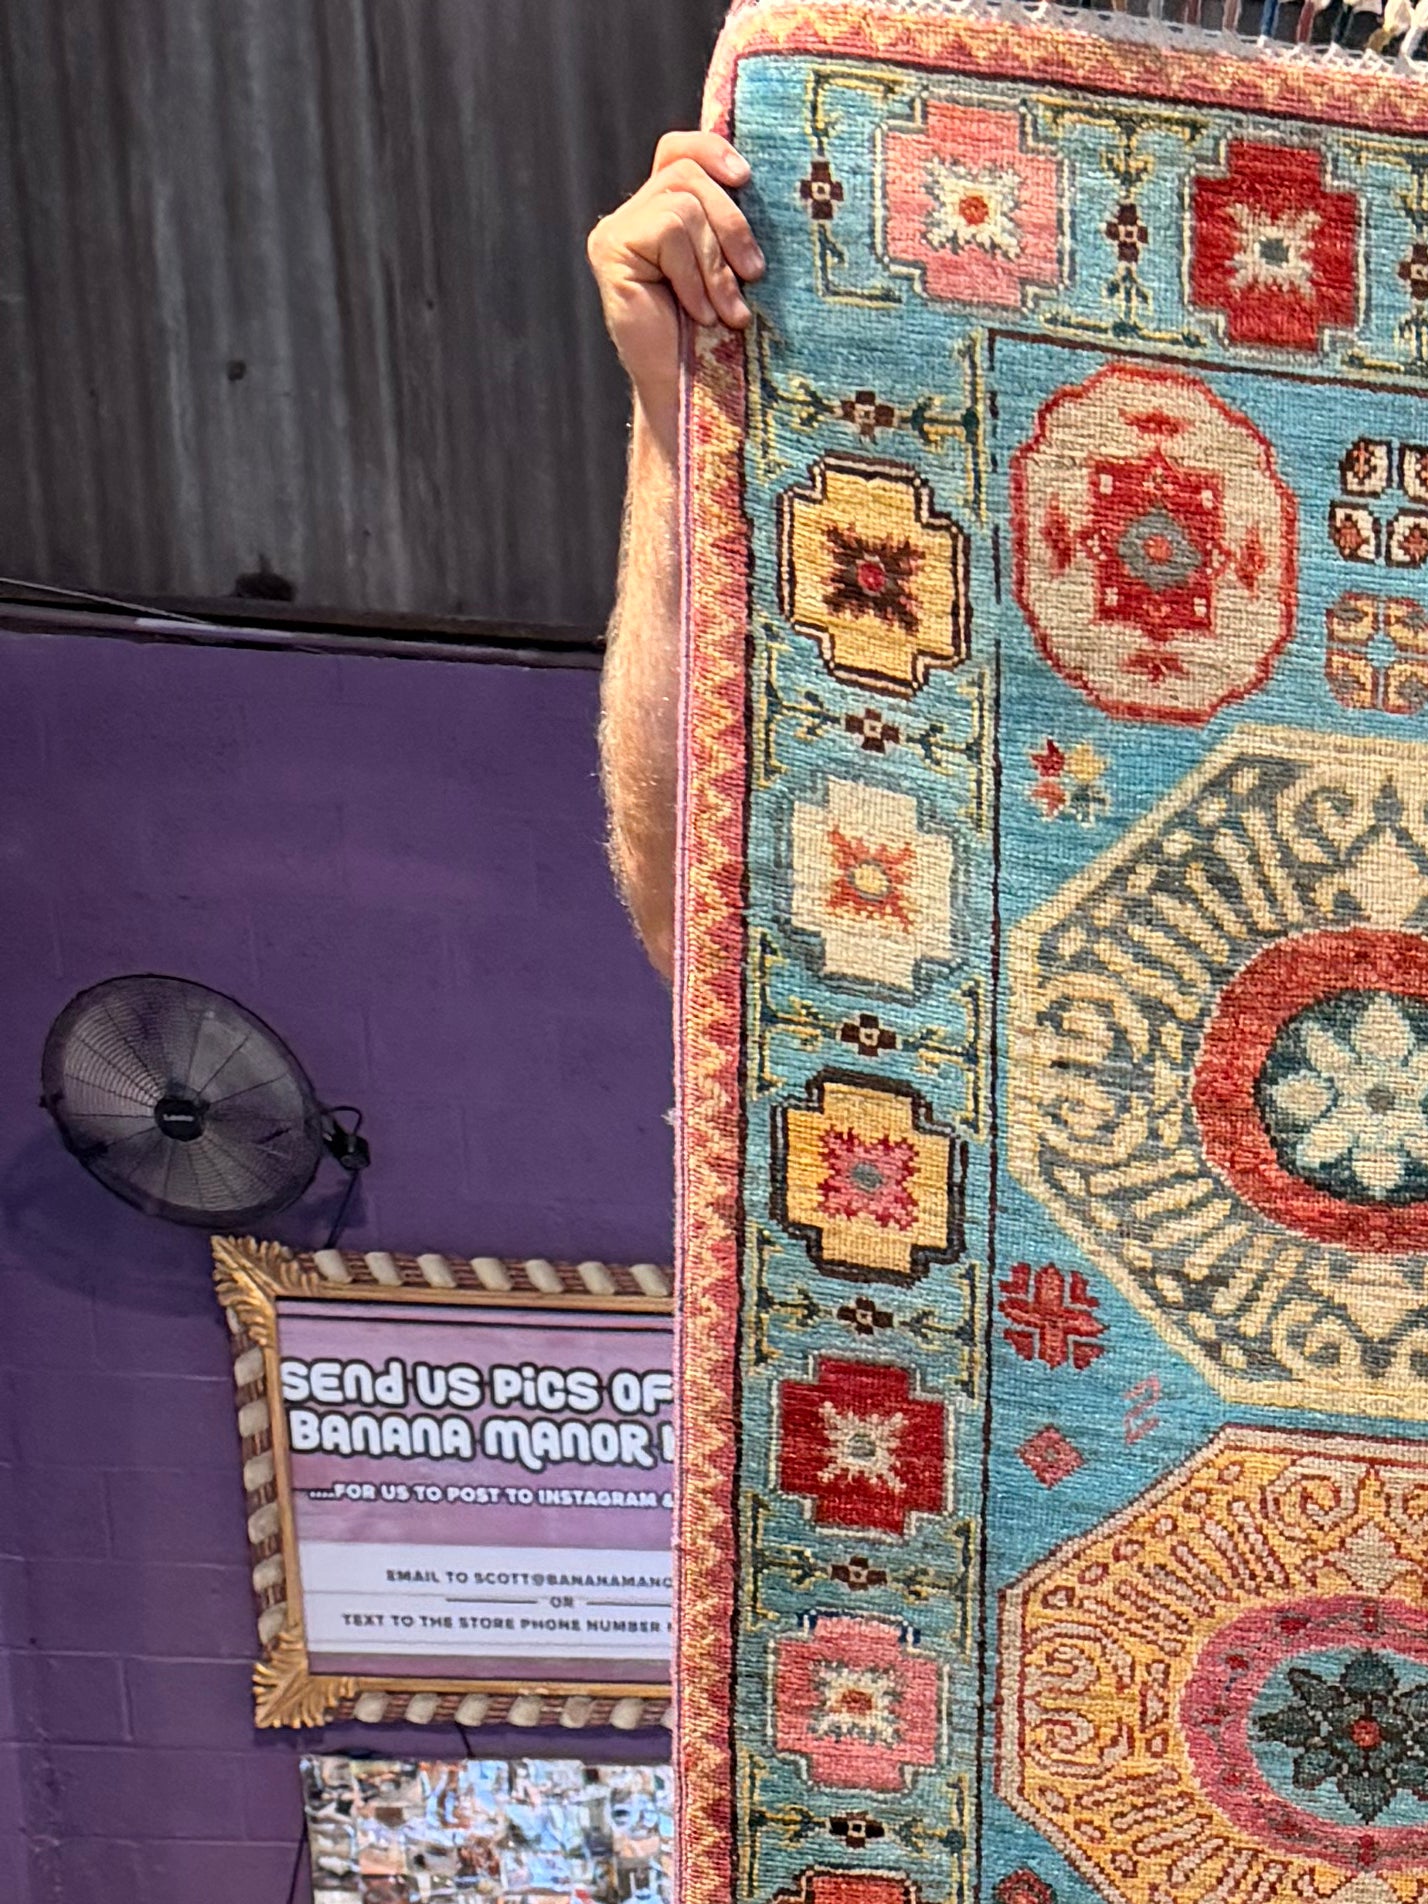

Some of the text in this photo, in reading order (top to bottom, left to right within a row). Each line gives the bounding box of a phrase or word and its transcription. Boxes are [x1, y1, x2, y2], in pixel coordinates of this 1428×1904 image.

[414, 1363, 481, 1408] US
[610, 1370, 674, 1414] OF
[380, 1484, 410, 1501] US
[413, 1485, 442, 1502] TO
[446, 1486, 500, 1504] POST
[504, 1488, 534, 1504] TO
[537, 1489, 658, 1507] INSTAGRAM
[386, 1569, 440, 1583] EMAIL
[446, 1571, 468, 1584] TO
[551, 1596, 574, 1609] OR
[342, 1613, 384, 1627] TEXT
[391, 1615, 414, 1628] TO
[419, 1615, 453, 1629] THE
[458, 1617, 515, 1630] STORE
[521, 1618, 581, 1632] PHONE
[586, 1620, 661, 1633] NUMBER
